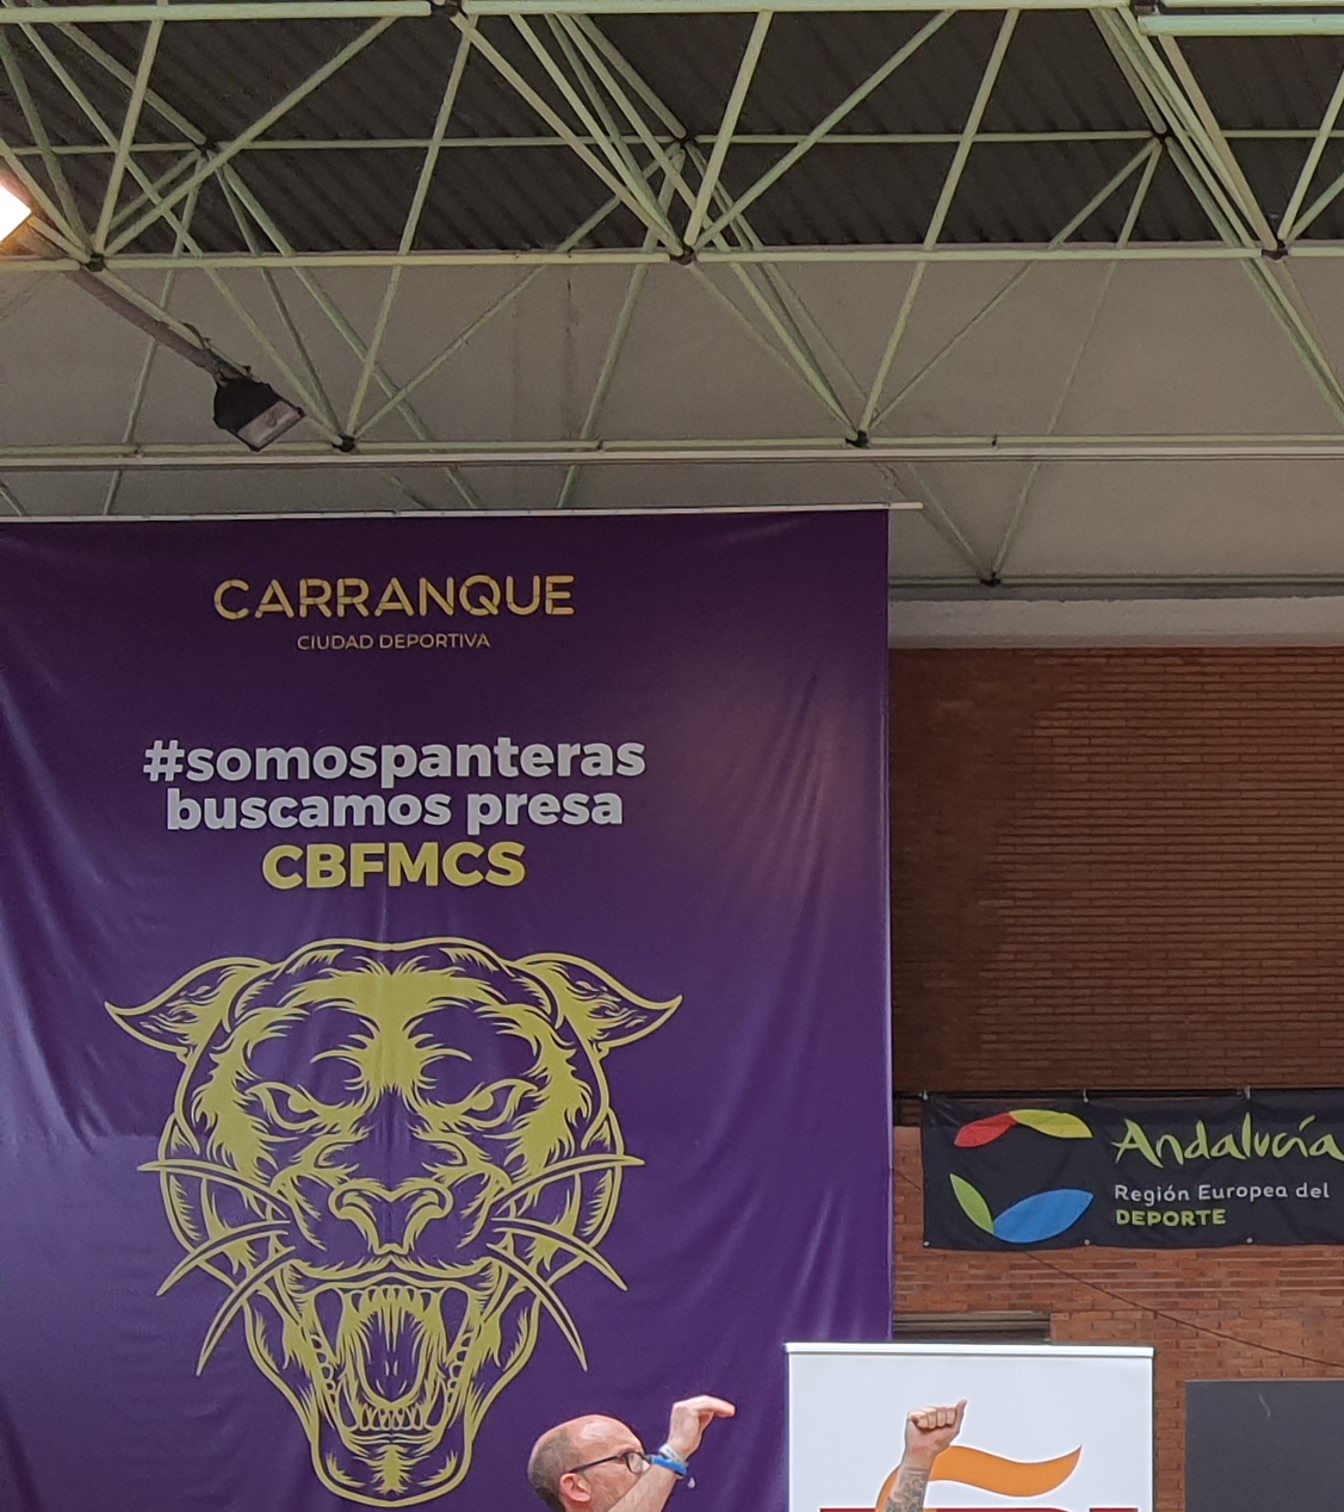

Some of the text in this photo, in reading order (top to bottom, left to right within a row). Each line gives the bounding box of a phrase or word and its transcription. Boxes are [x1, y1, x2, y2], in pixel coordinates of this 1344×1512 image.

[213, 575, 575, 620] CARRANQUE
[297, 632, 490, 650] CIUDAD DEPORTIVA
[143, 737, 645, 788] #somospanteras
[167, 788, 624, 835] buscamos presa
[262, 841, 526, 889] CBFMCS
[1115, 1182, 1330, 1207] Región Europea del
[1116, 1209, 1226, 1227] DEPORTE
